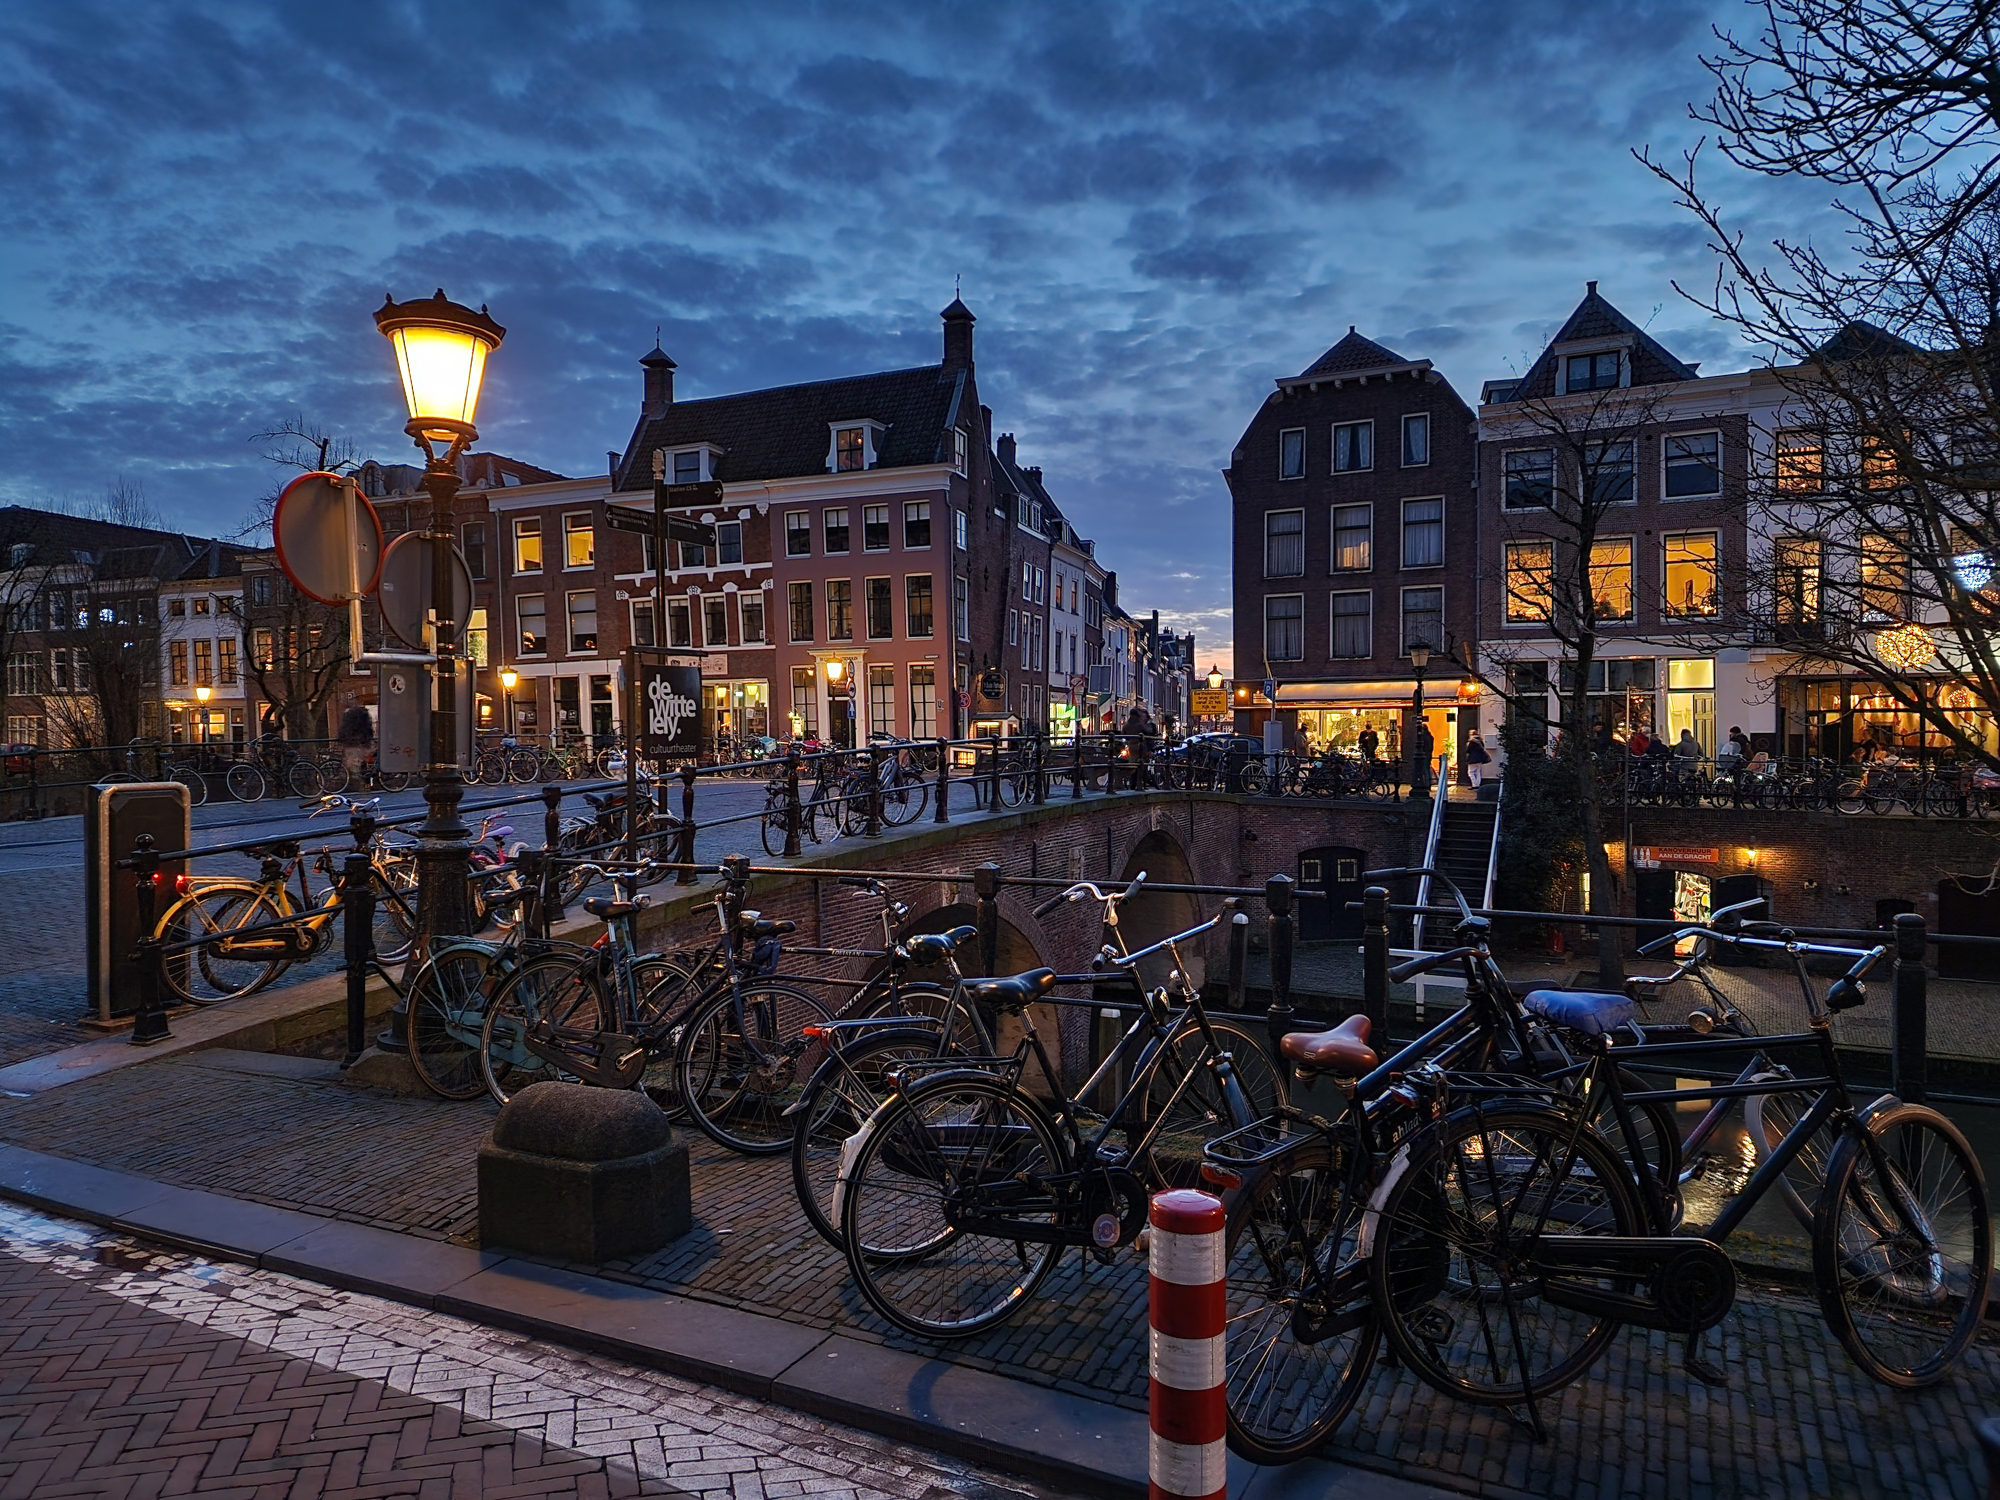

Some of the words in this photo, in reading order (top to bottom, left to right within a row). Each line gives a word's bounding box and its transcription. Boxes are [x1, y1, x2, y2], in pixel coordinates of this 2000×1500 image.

[648, 673, 674, 701] de
[653, 694, 697, 718] witte
[649, 708, 682, 742] lely.
[649, 743, 697, 755] cultuurtheater
